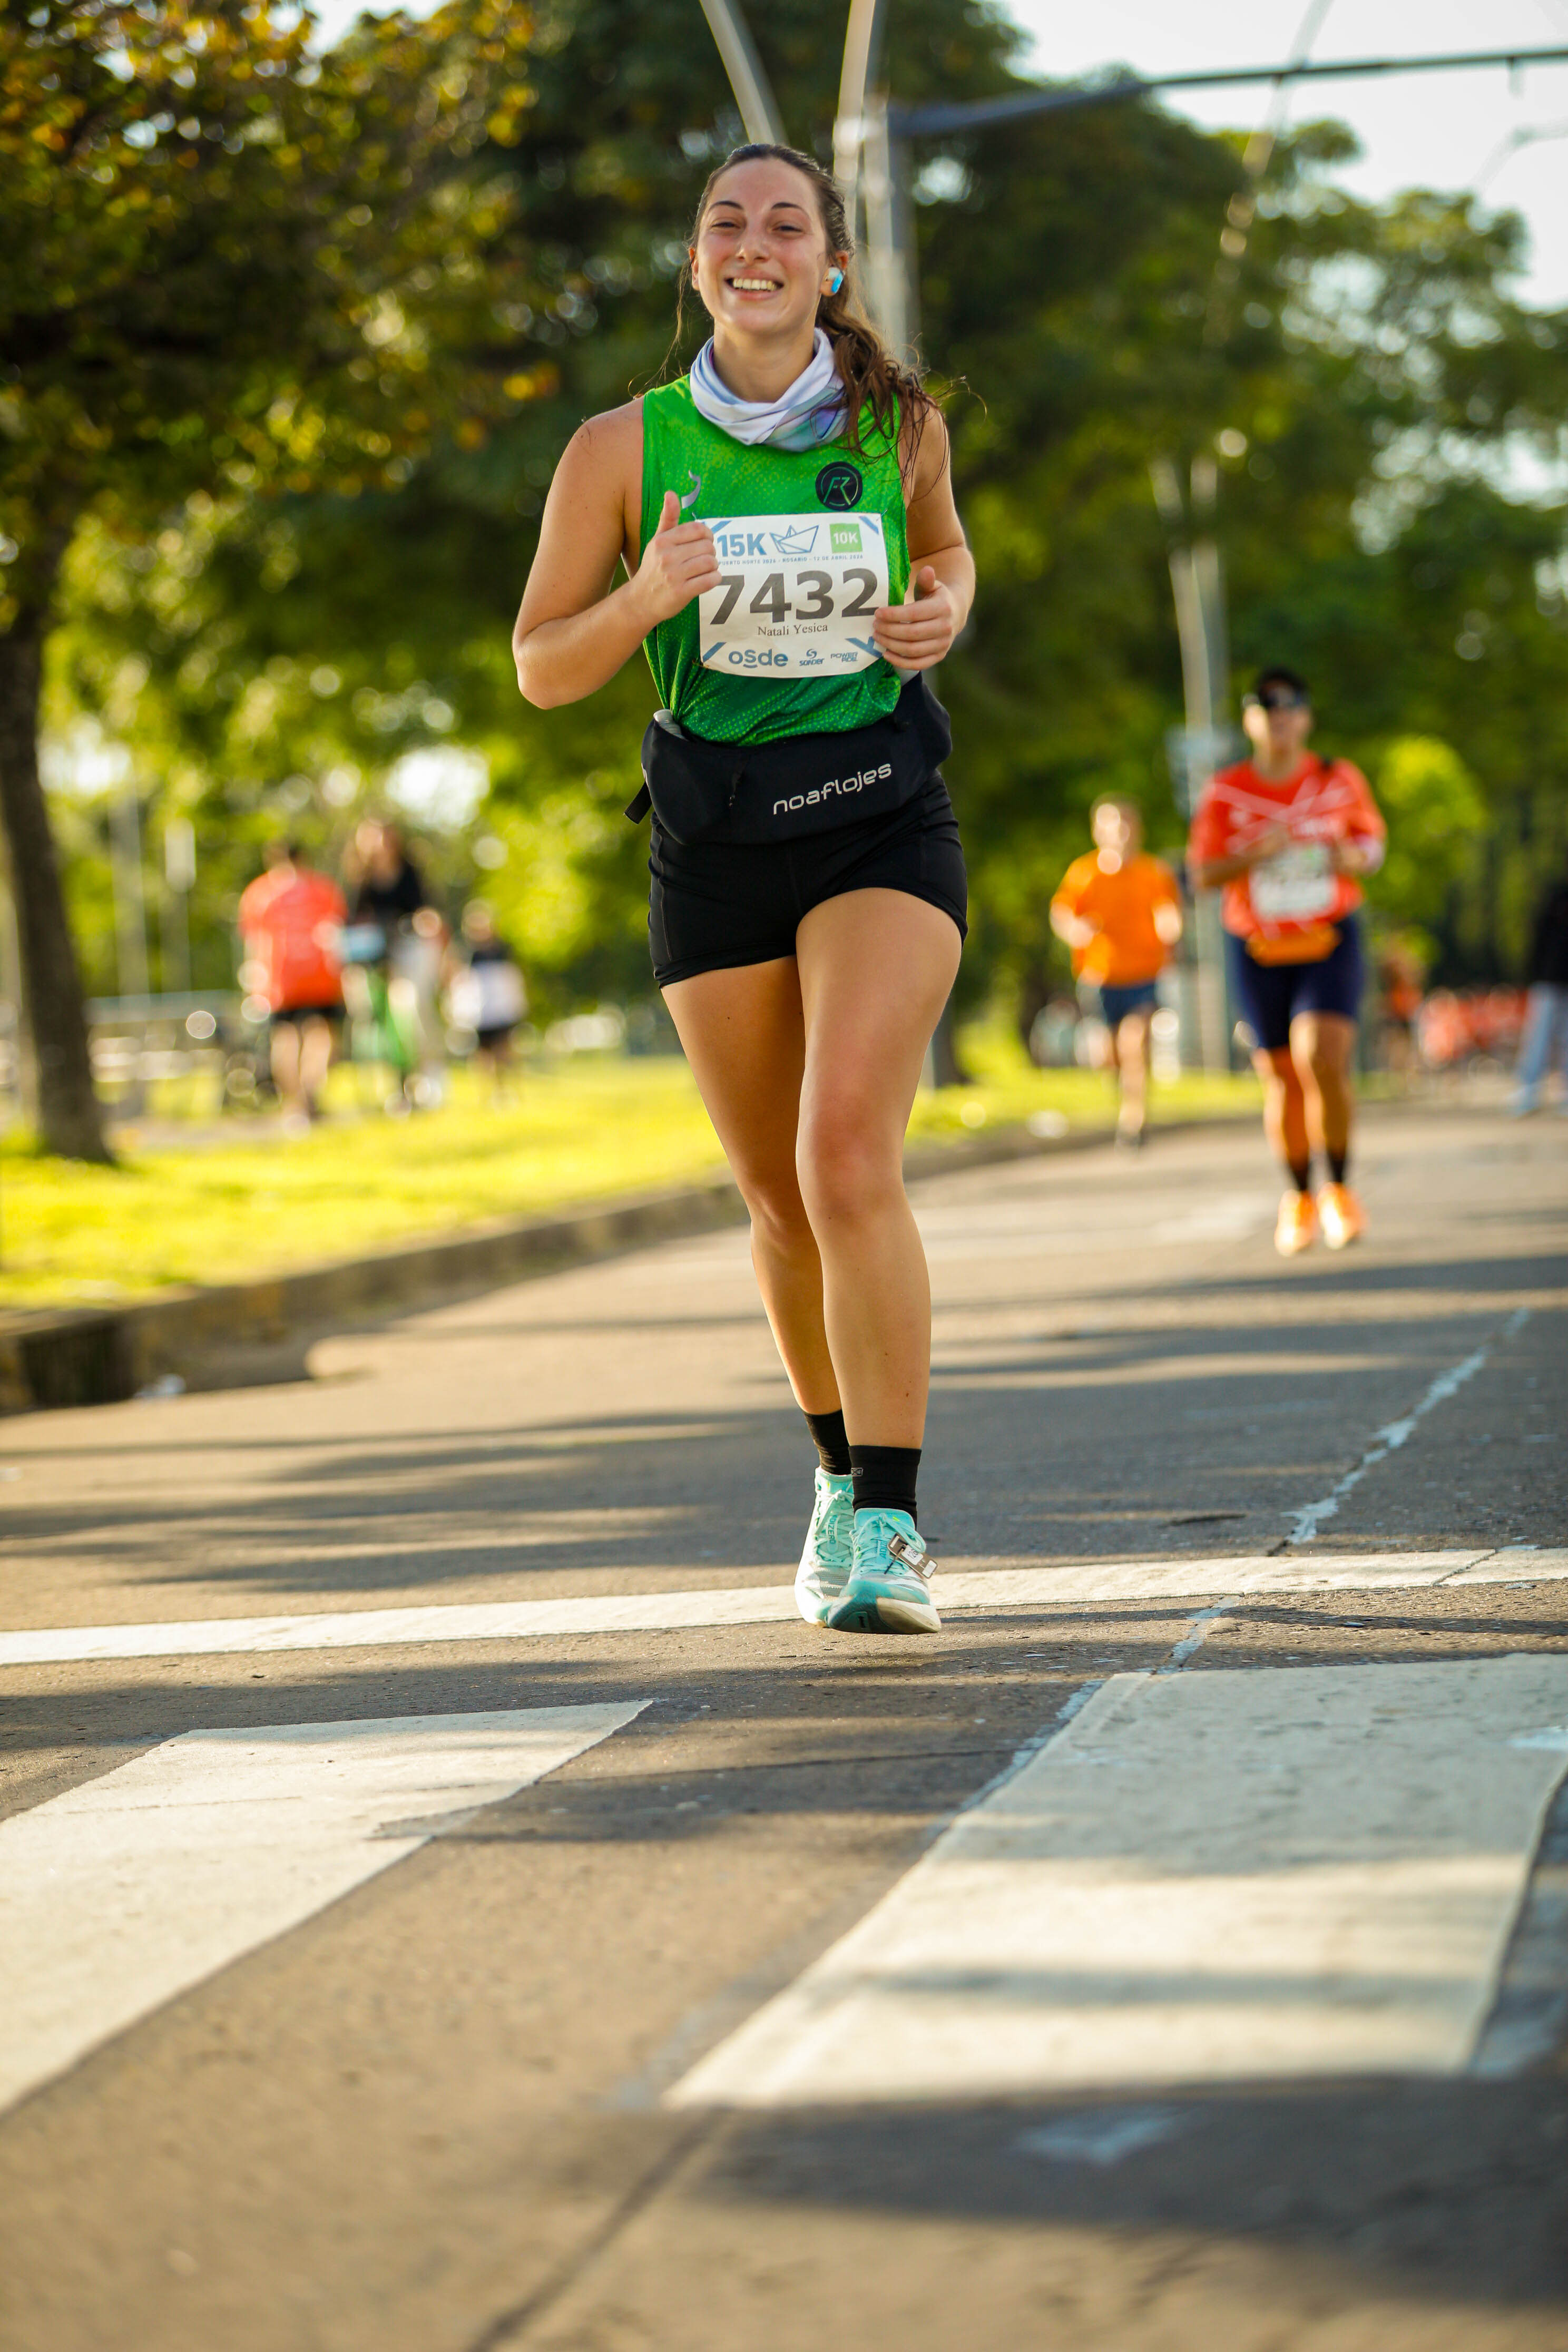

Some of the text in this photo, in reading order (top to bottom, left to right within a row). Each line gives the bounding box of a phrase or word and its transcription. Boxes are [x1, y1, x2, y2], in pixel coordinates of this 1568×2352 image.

[717, 532, 767, 557] 15K
[833, 531, 859, 545] 10K
[710, 567, 879, 625] 7432
[758, 623, 828, 636] Natali Yesica
[728, 649, 789, 668] osde
[773, 763, 892, 815] noaflojes
